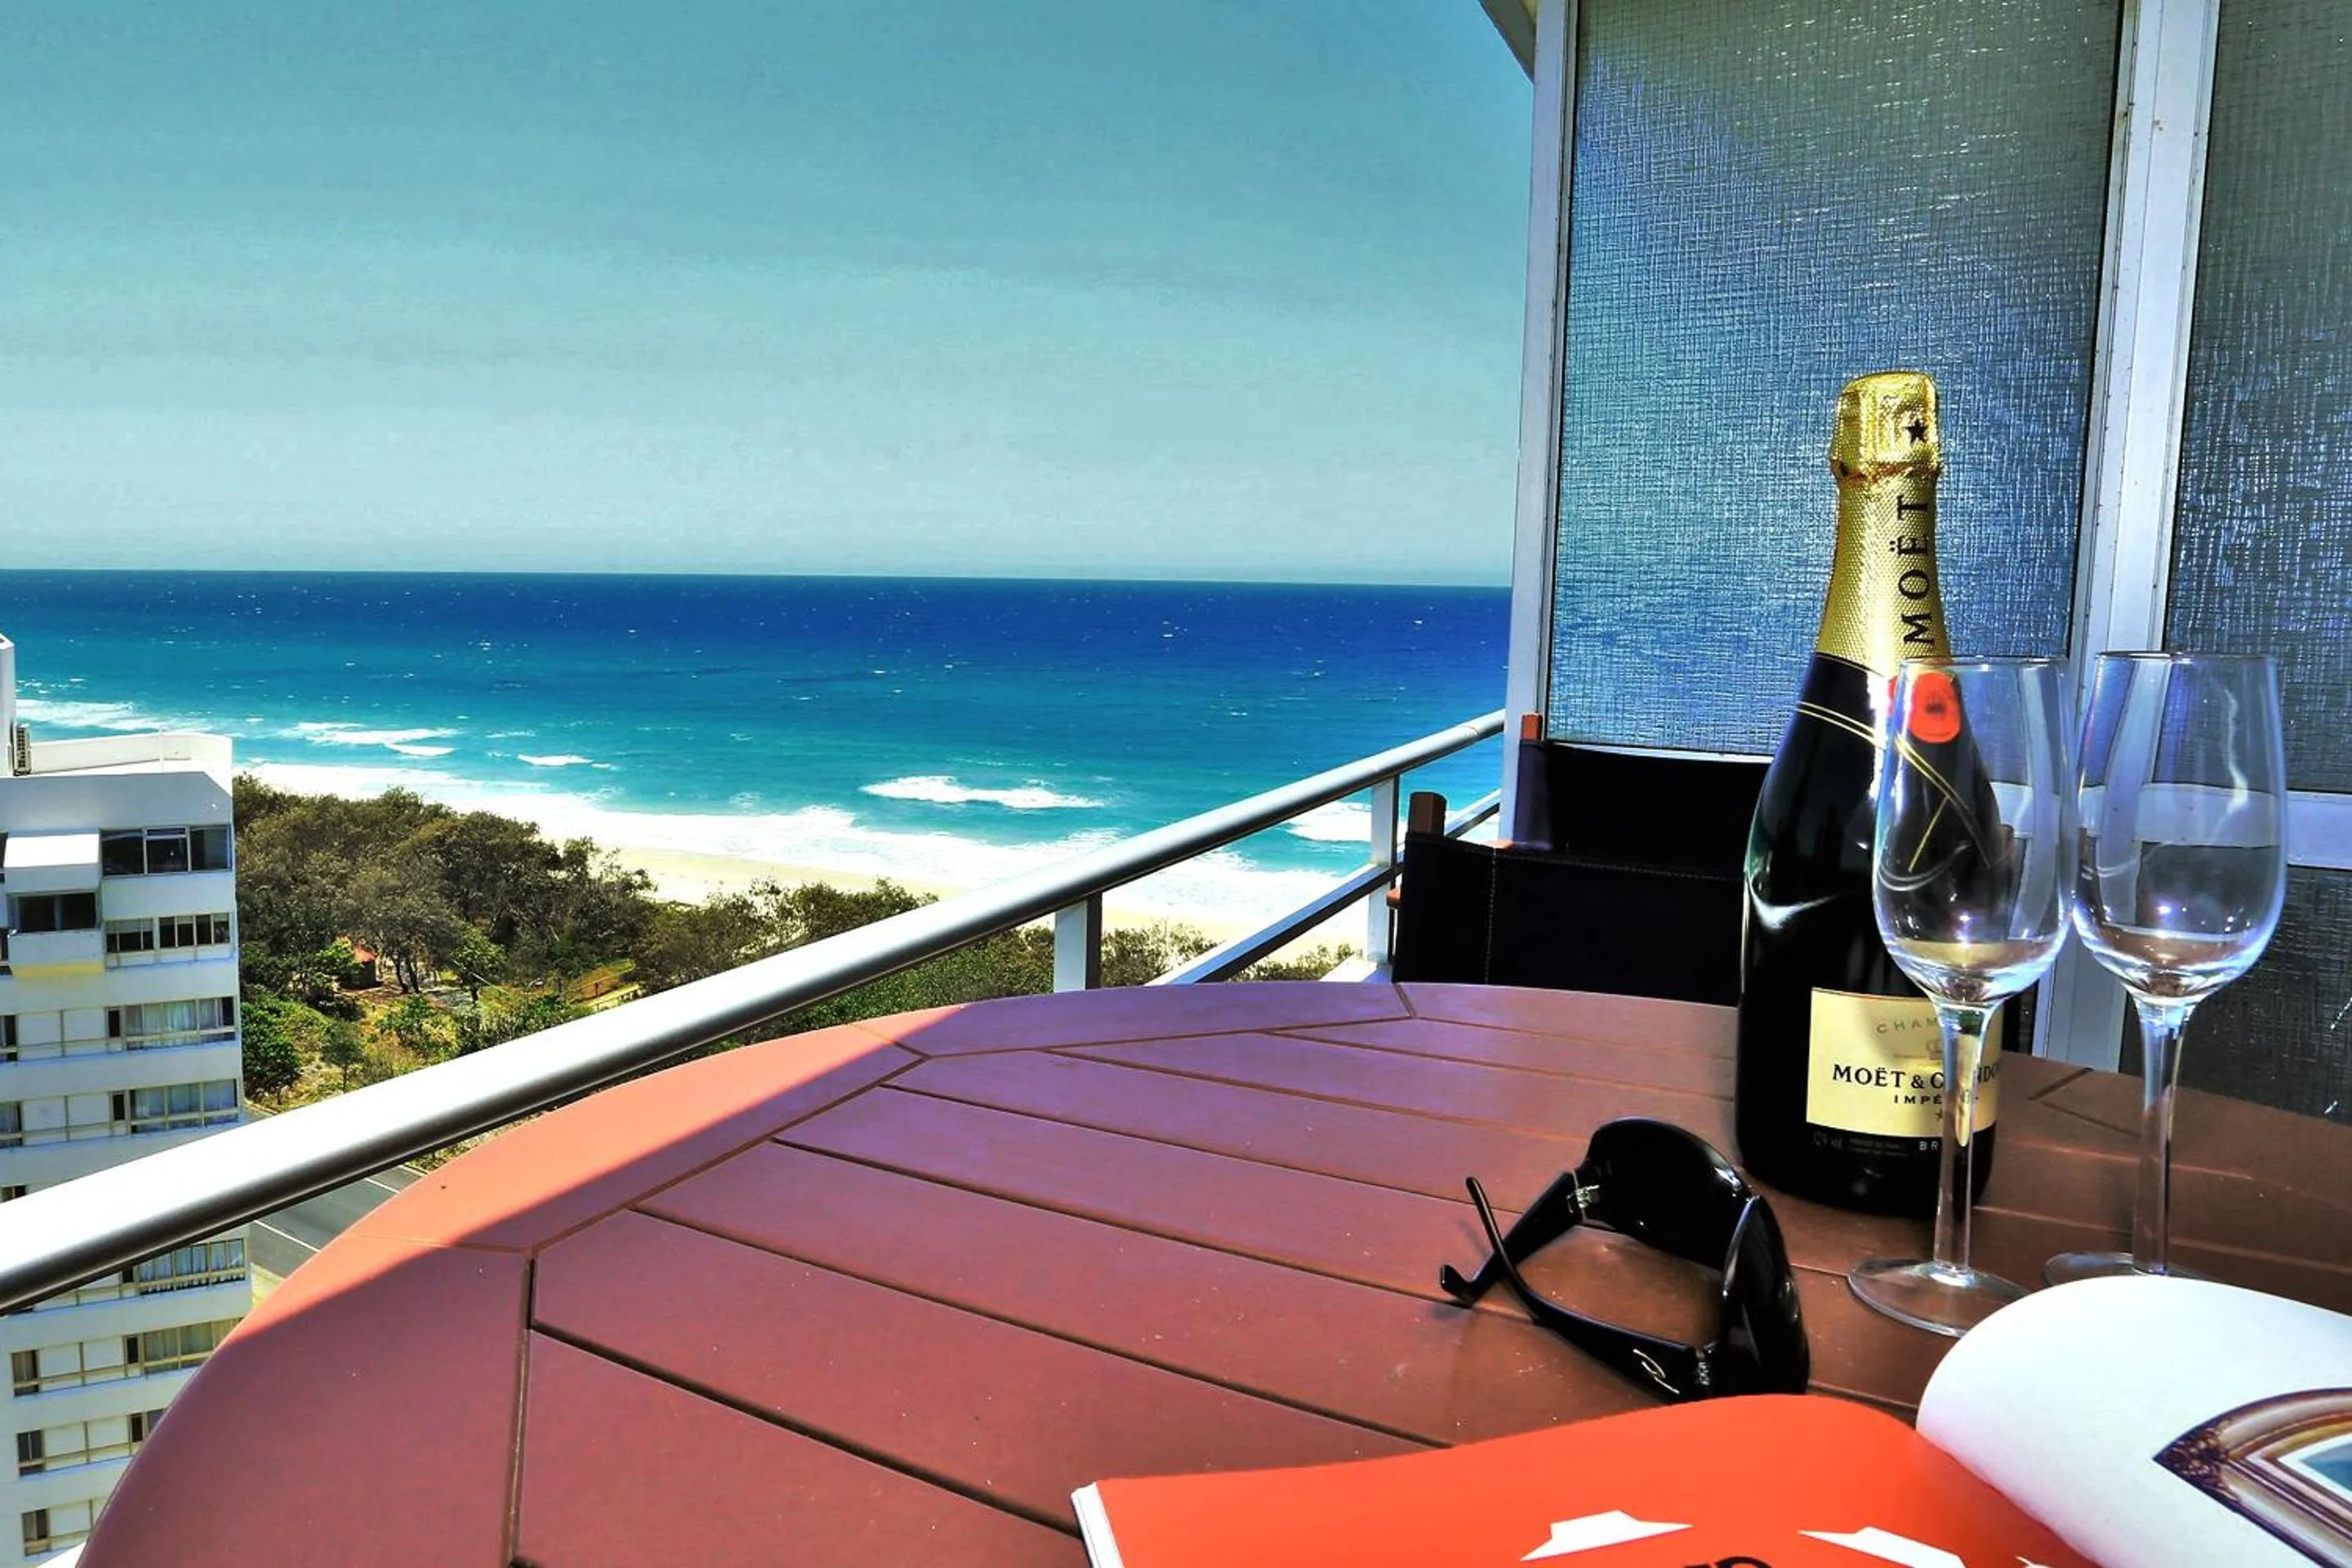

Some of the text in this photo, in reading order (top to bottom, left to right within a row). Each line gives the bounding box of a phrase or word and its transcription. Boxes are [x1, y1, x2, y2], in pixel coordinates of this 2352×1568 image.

[1889, 494, 1935, 645] MOËT
[1832, 1063, 1907, 1088] MOËT
[1911, 1074, 1926, 1089] &
[1894, 1094, 1942, 1105] IMPÉ
